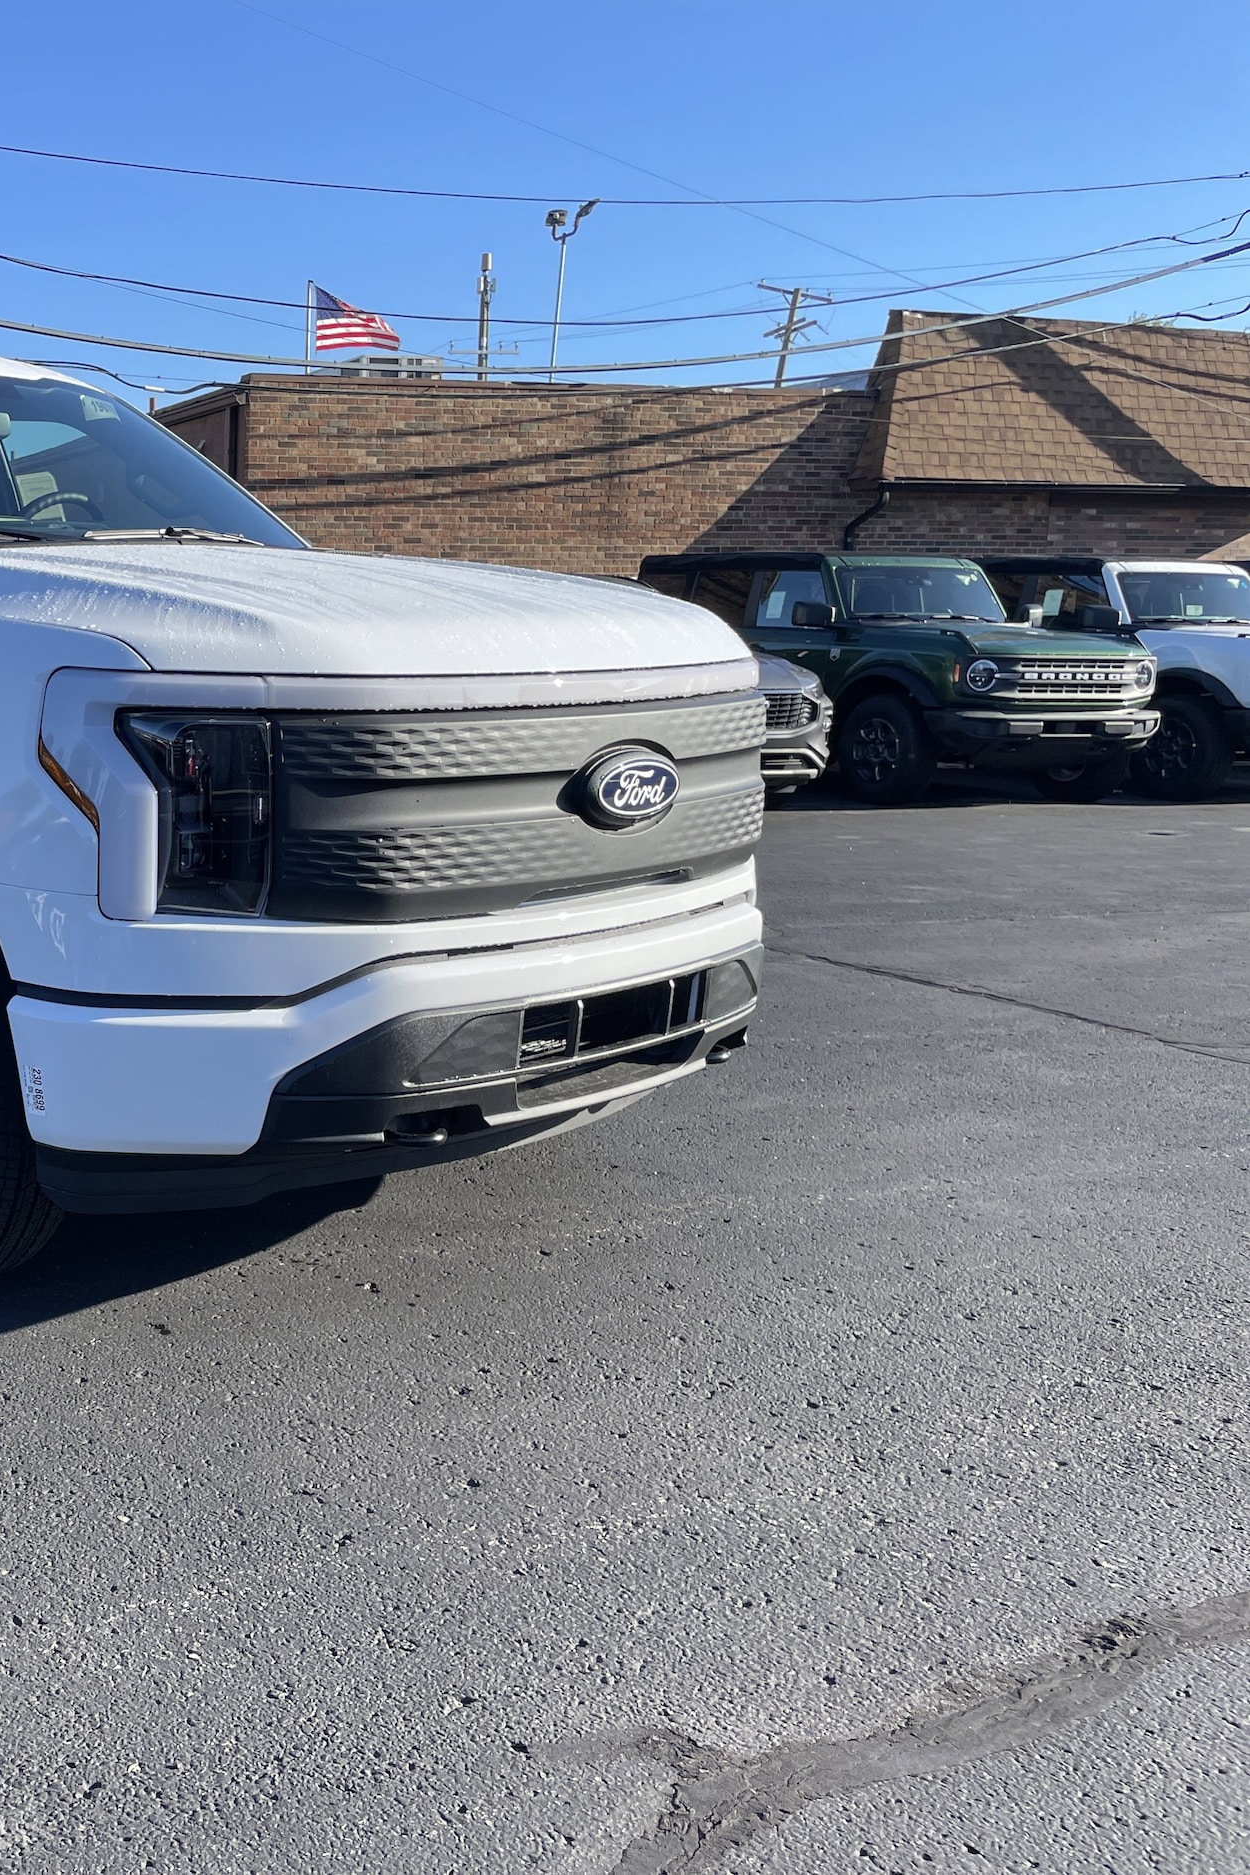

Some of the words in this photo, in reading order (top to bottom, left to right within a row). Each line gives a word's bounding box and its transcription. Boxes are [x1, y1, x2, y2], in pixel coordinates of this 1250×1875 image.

[1024, 672, 1121, 680] BRONCO
[614, 770, 666, 807] Ford
[32, 1068, 43, 1086] 230
